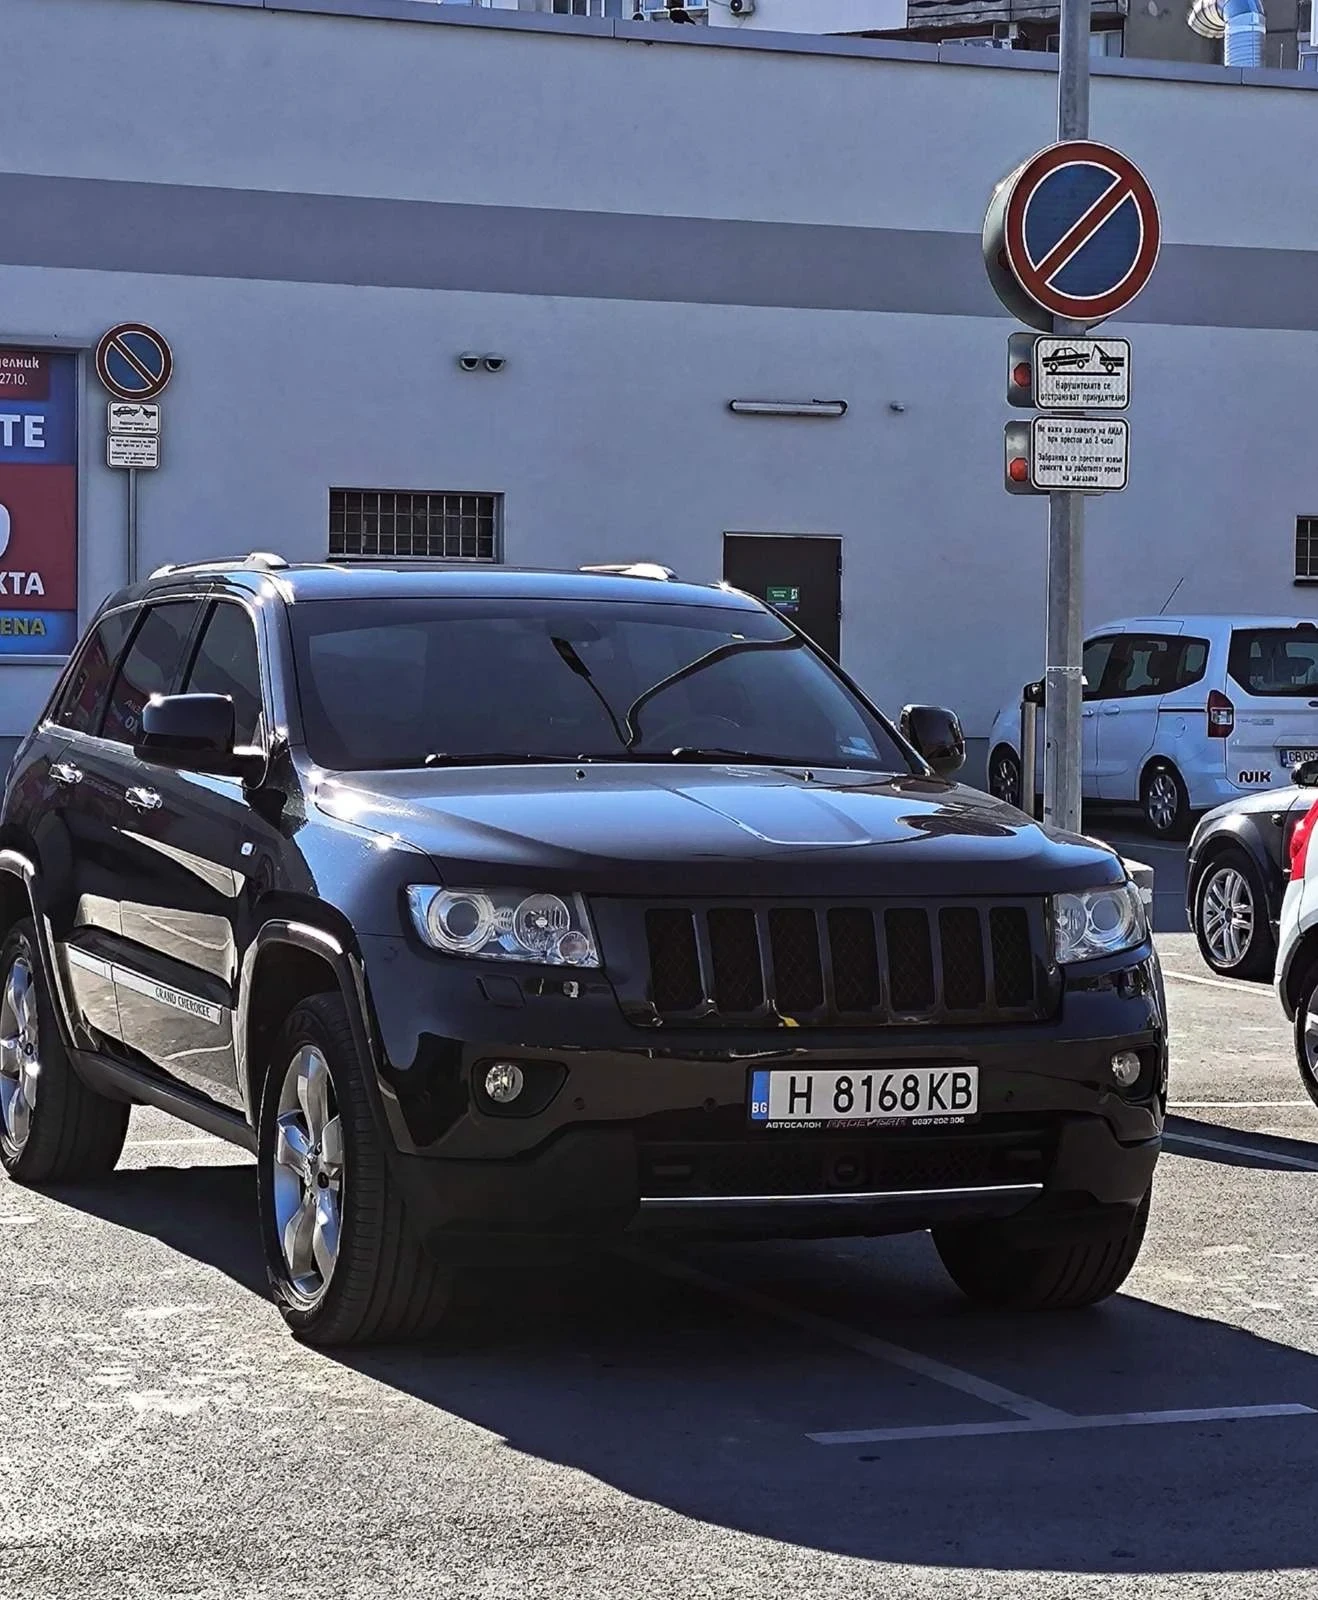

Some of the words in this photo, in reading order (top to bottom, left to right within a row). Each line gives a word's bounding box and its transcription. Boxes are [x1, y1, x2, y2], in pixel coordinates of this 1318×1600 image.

[0, 356, 40, 369] елник
[1055, 380, 1101, 391] Нарушителите
[1103, 382, 1111, 390] се
[1082, 393, 1126, 403] принудително
[1037, 424, 1045, 433] Не
[1107, 427, 1123, 435] ЛИДЛ
[1047, 436, 1058, 444] при
[1094, 436, 1099, 444] 2
[1038, 453, 1068, 463] Забранява
[1039, 464, 1063, 473] рамките
[1074, 464, 1102, 473] работното
[1104, 466, 1121, 474] време
[1239, 771, 1272, 783] NIK
[155, 987, 177, 1005] GRAND
[178, 996, 211, 1018] CHEROKEE
[752, 1102, 768, 1113] BG
[766, 1121, 822, 1129] АВТОСАЛОН
